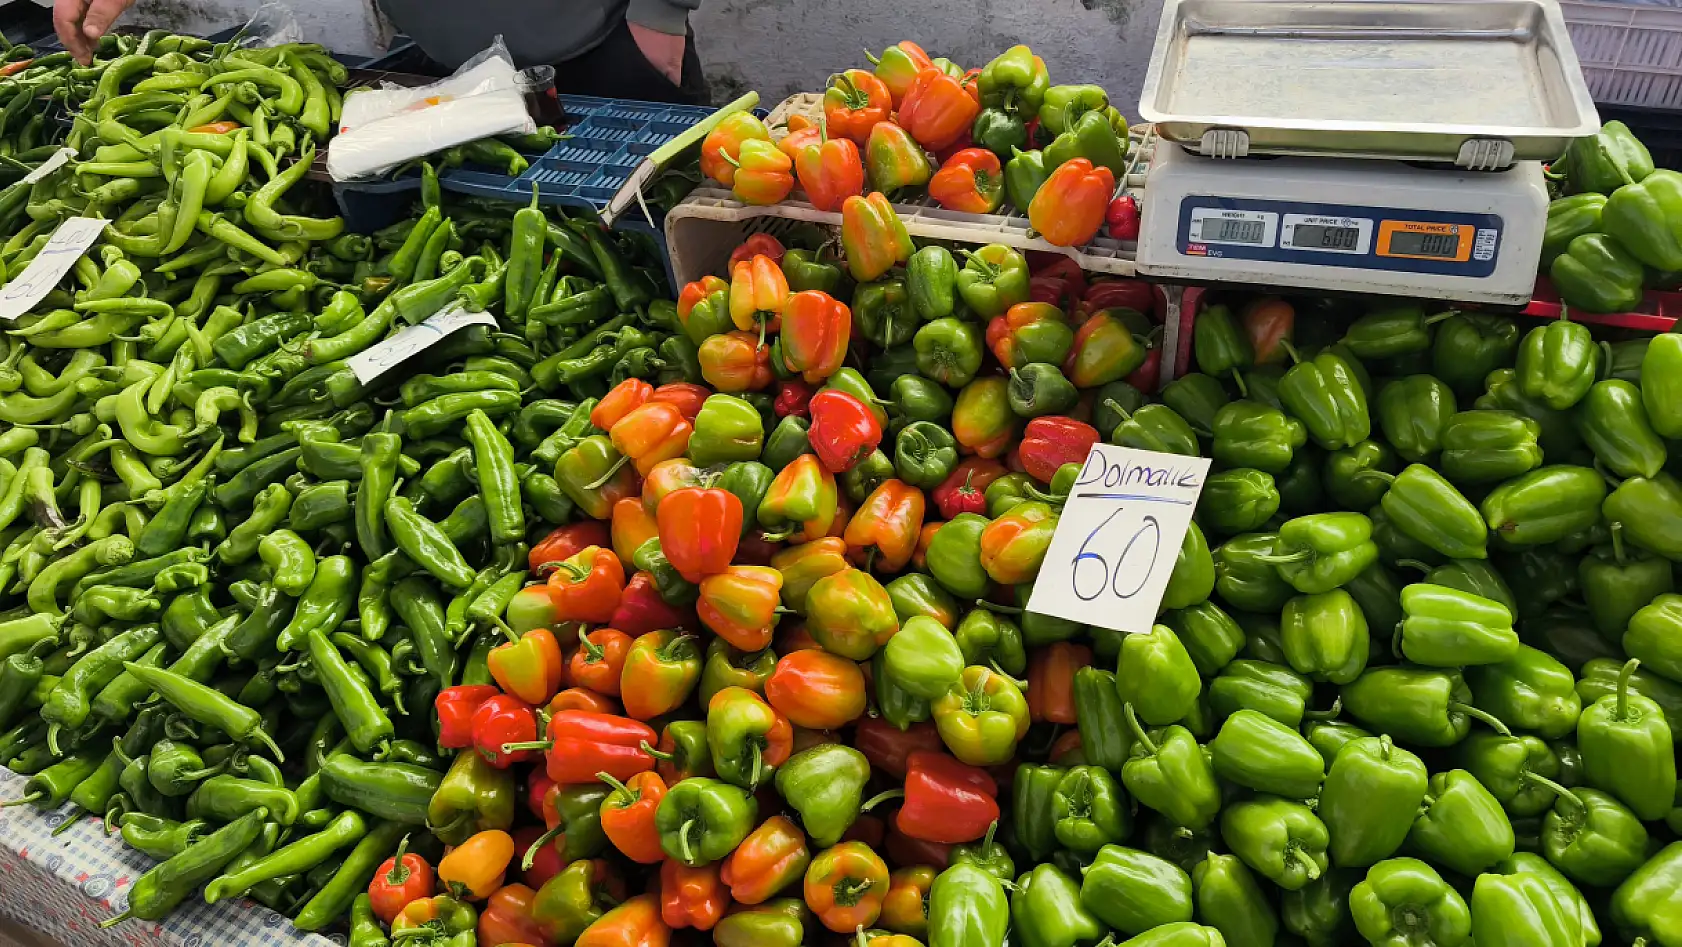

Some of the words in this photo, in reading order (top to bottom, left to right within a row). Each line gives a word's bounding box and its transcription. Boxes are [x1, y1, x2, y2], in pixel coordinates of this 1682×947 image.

[1221, 211, 1246, 219] WEIGHT
[1426, 225, 1447, 233] PRICE
[1071, 507, 1161, 602] 60
